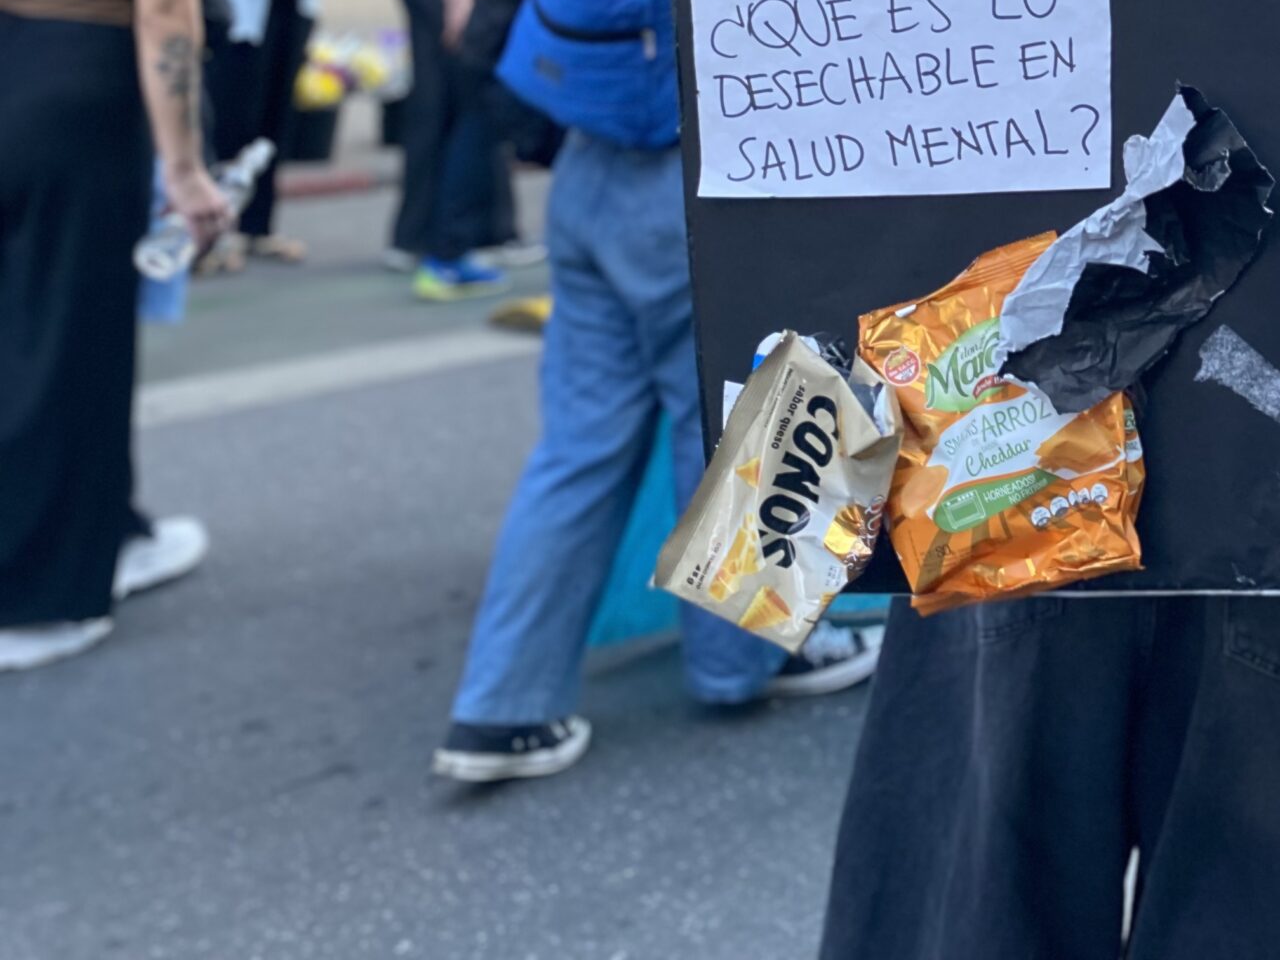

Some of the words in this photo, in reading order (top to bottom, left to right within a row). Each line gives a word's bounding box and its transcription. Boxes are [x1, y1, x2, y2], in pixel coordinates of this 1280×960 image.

[713, 45, 999, 118] DESECHABLE
[1019, 37, 1076, 80] EN
[727, 133, 865, 182] SALUD
[885, 103, 1100, 172] MENTAL?
[786, 385, 806, 416] sabor
[926, 331, 1001, 409] Marc
[771, 417, 790, 450] queso
[981, 396, 1052, 441] ARROZ
[759, 395, 839, 569] CONOS
[965, 439, 1032, 477] Cheddar
